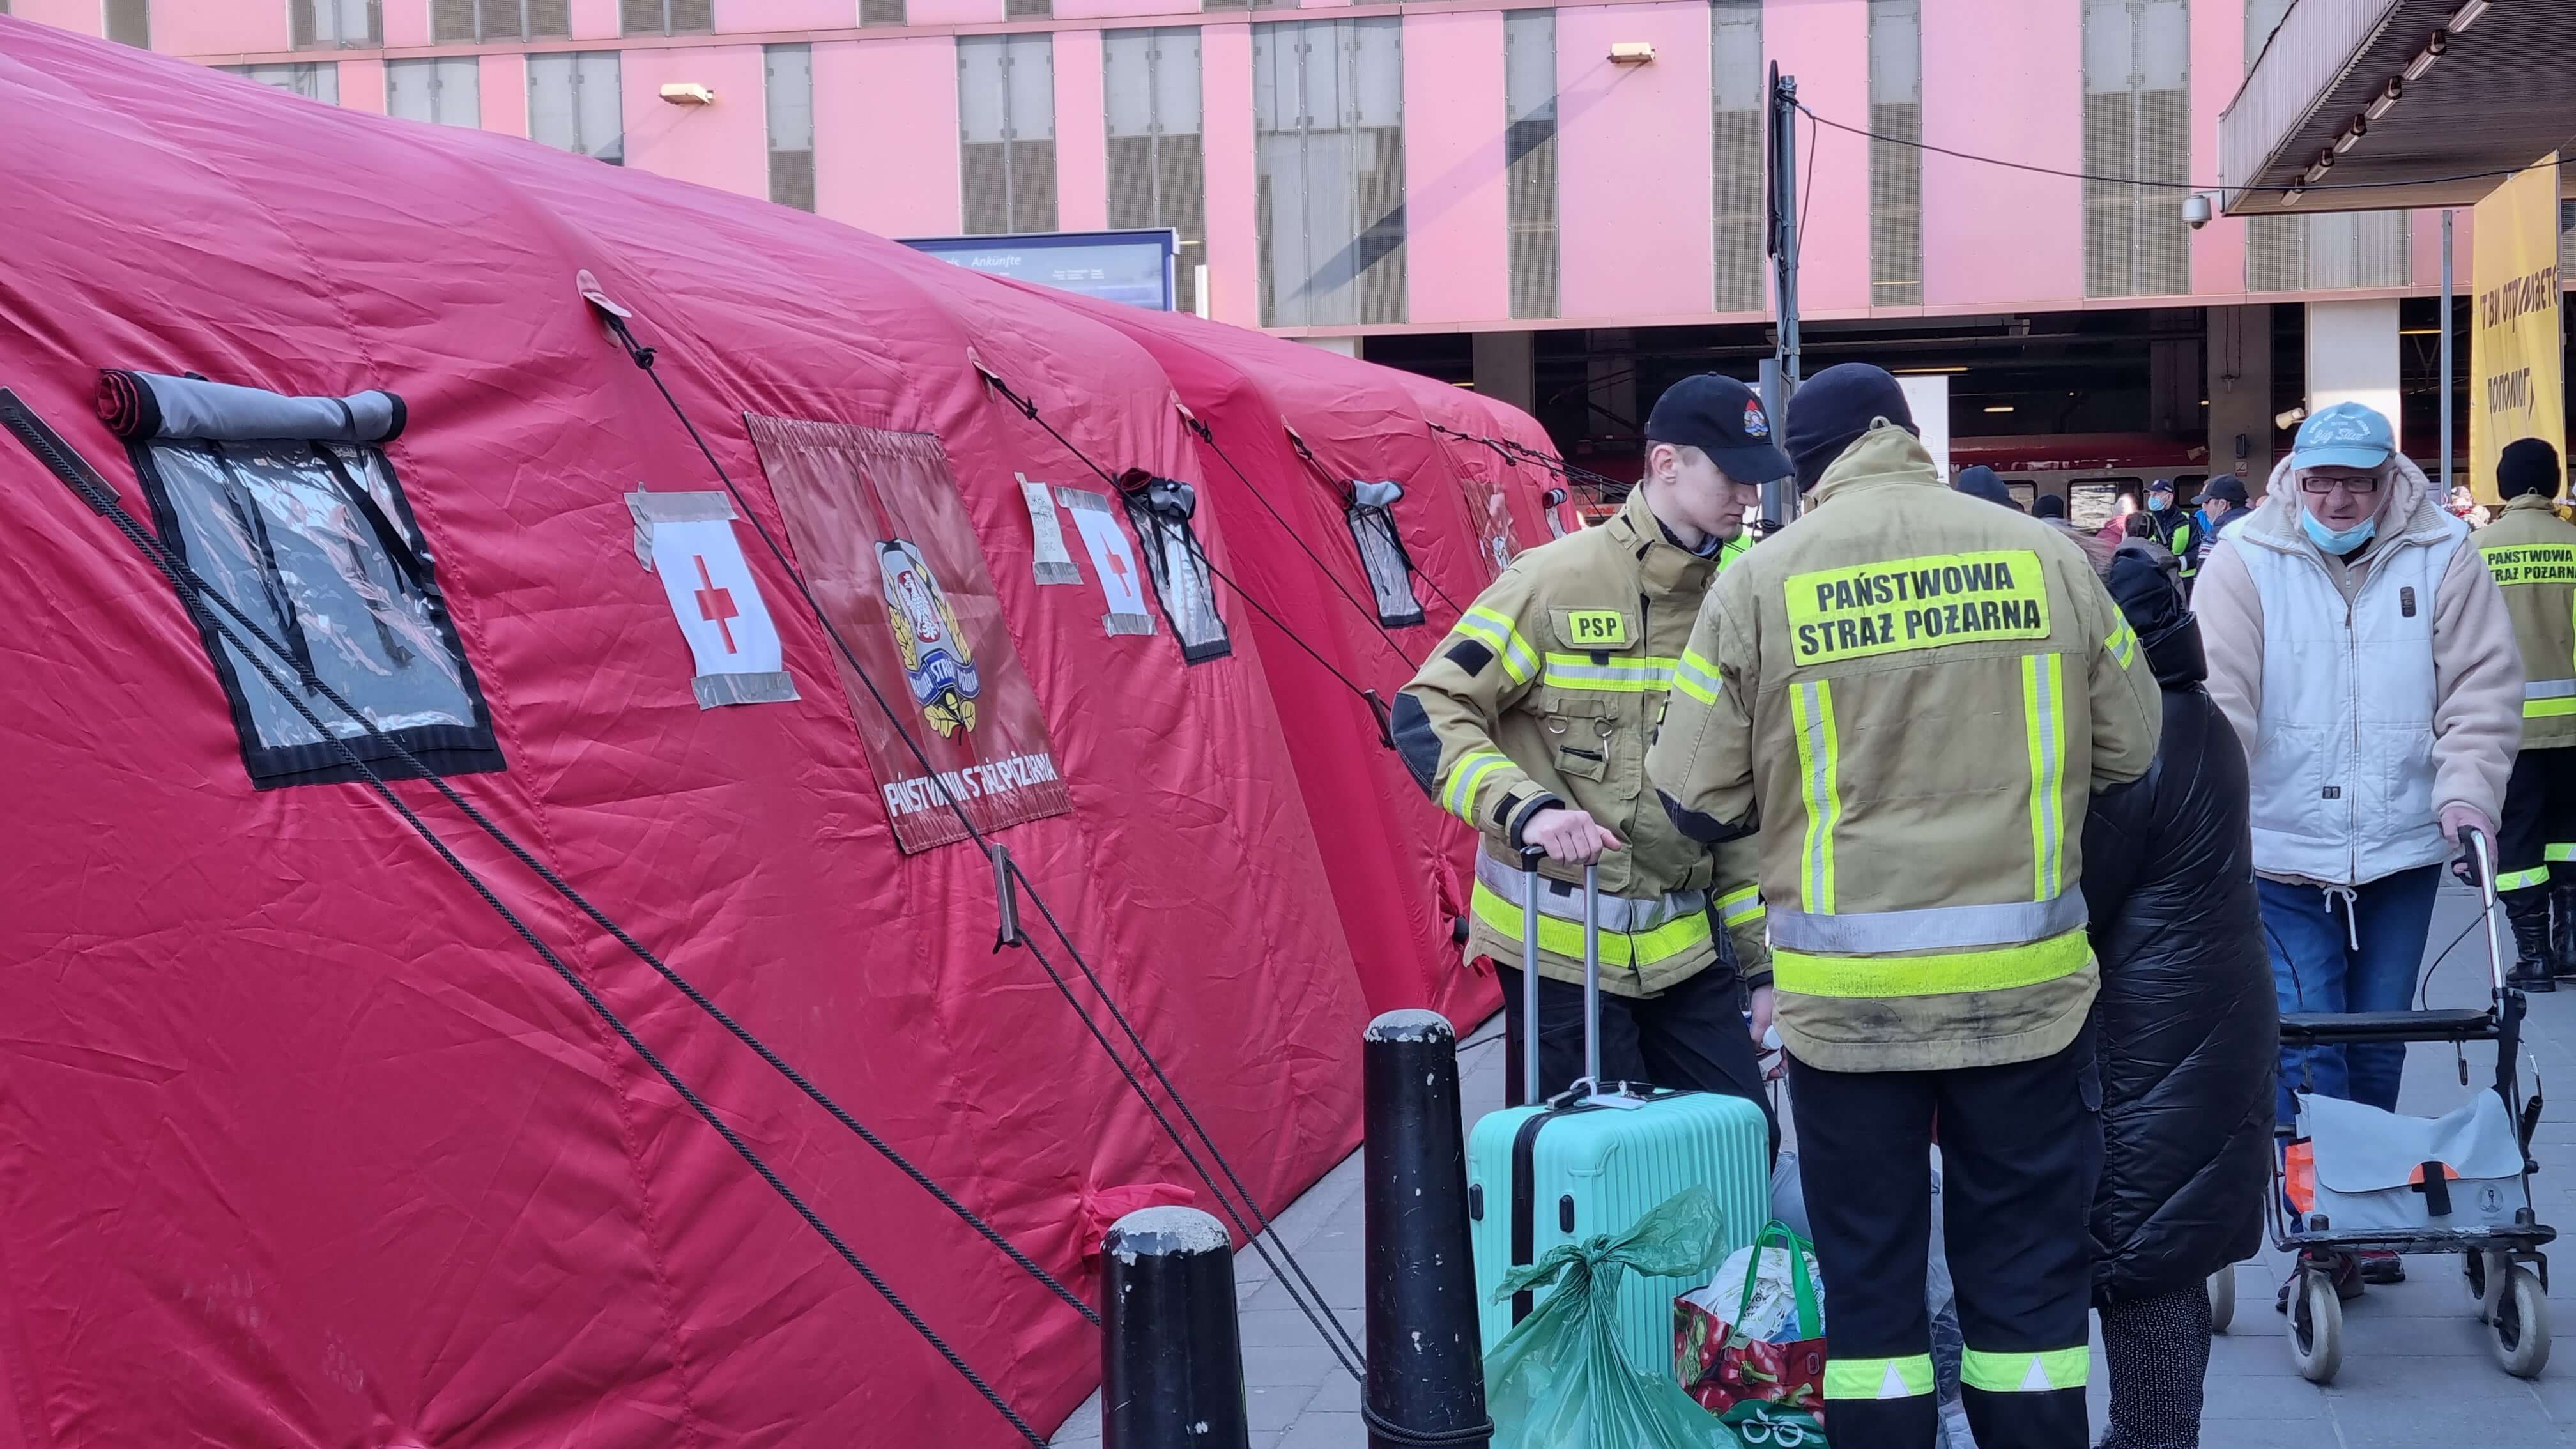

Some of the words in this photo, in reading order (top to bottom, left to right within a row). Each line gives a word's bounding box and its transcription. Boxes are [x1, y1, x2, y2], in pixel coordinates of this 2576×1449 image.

[971, 255, 1022, 268] Ankünfte
[2488, 549, 2573, 565] PAŃSTWOWA
[2490, 567, 2519, 582] RAŻ
[2524, 566, 2576, 579] POŻARN
[1816, 562, 2015, 612] PAŃSTWOWA
[1579, 617, 1617, 638] PSP
[1798, 613, 1896, 656] STRAŻ
[1905, 599, 2041, 640] POŻARNA
[883, 771, 971, 817] PŃSTWWA
